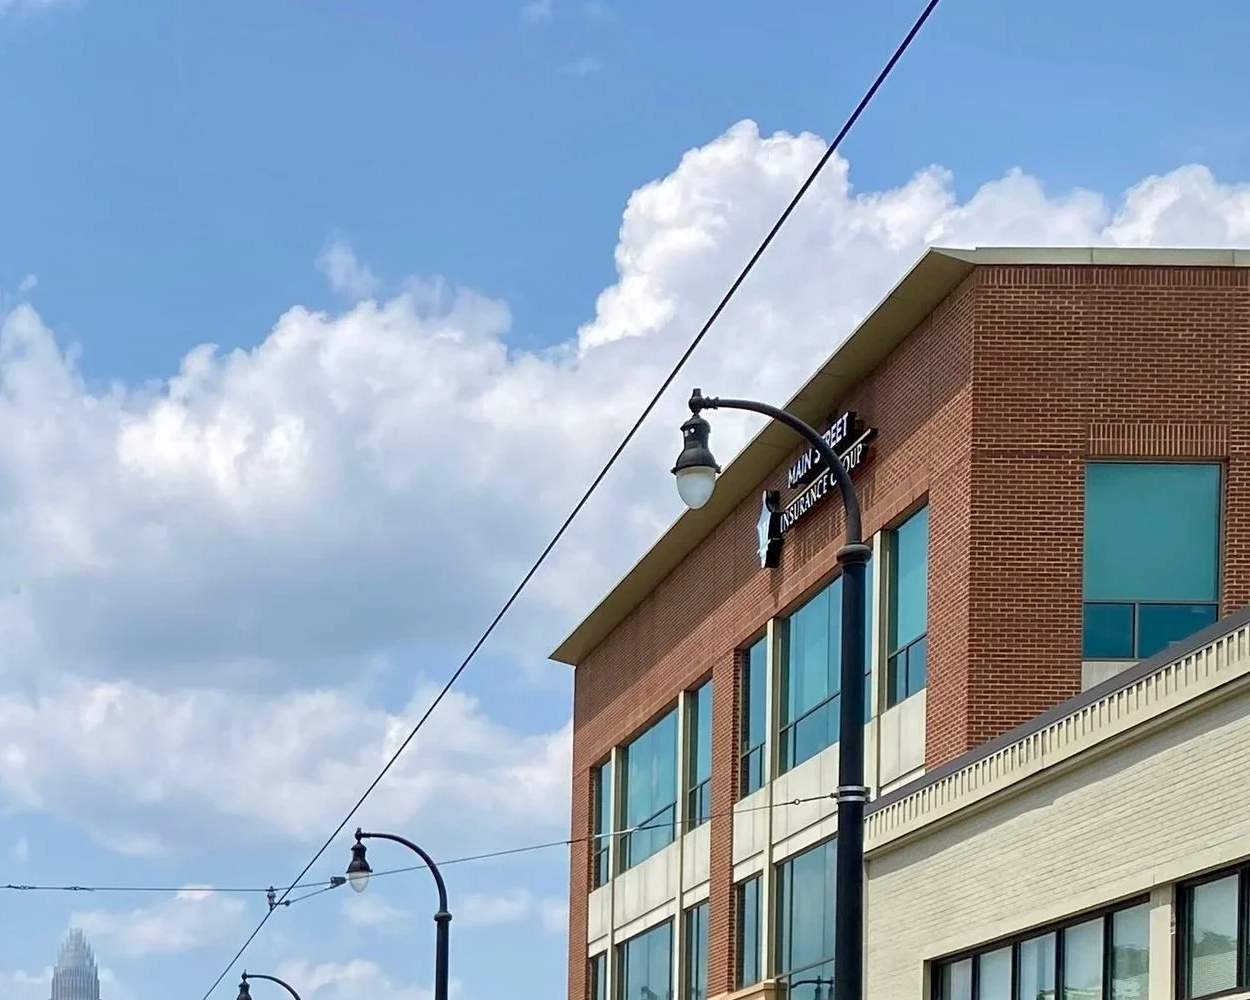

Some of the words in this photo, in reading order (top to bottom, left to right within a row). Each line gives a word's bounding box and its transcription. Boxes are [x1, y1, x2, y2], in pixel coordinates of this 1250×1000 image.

[780, 474, 829, 533] INSURANCE
[830, 443, 863, 486] GOUP
[788, 448, 812, 489] MAIN
[813, 411, 849, 464] SREET
